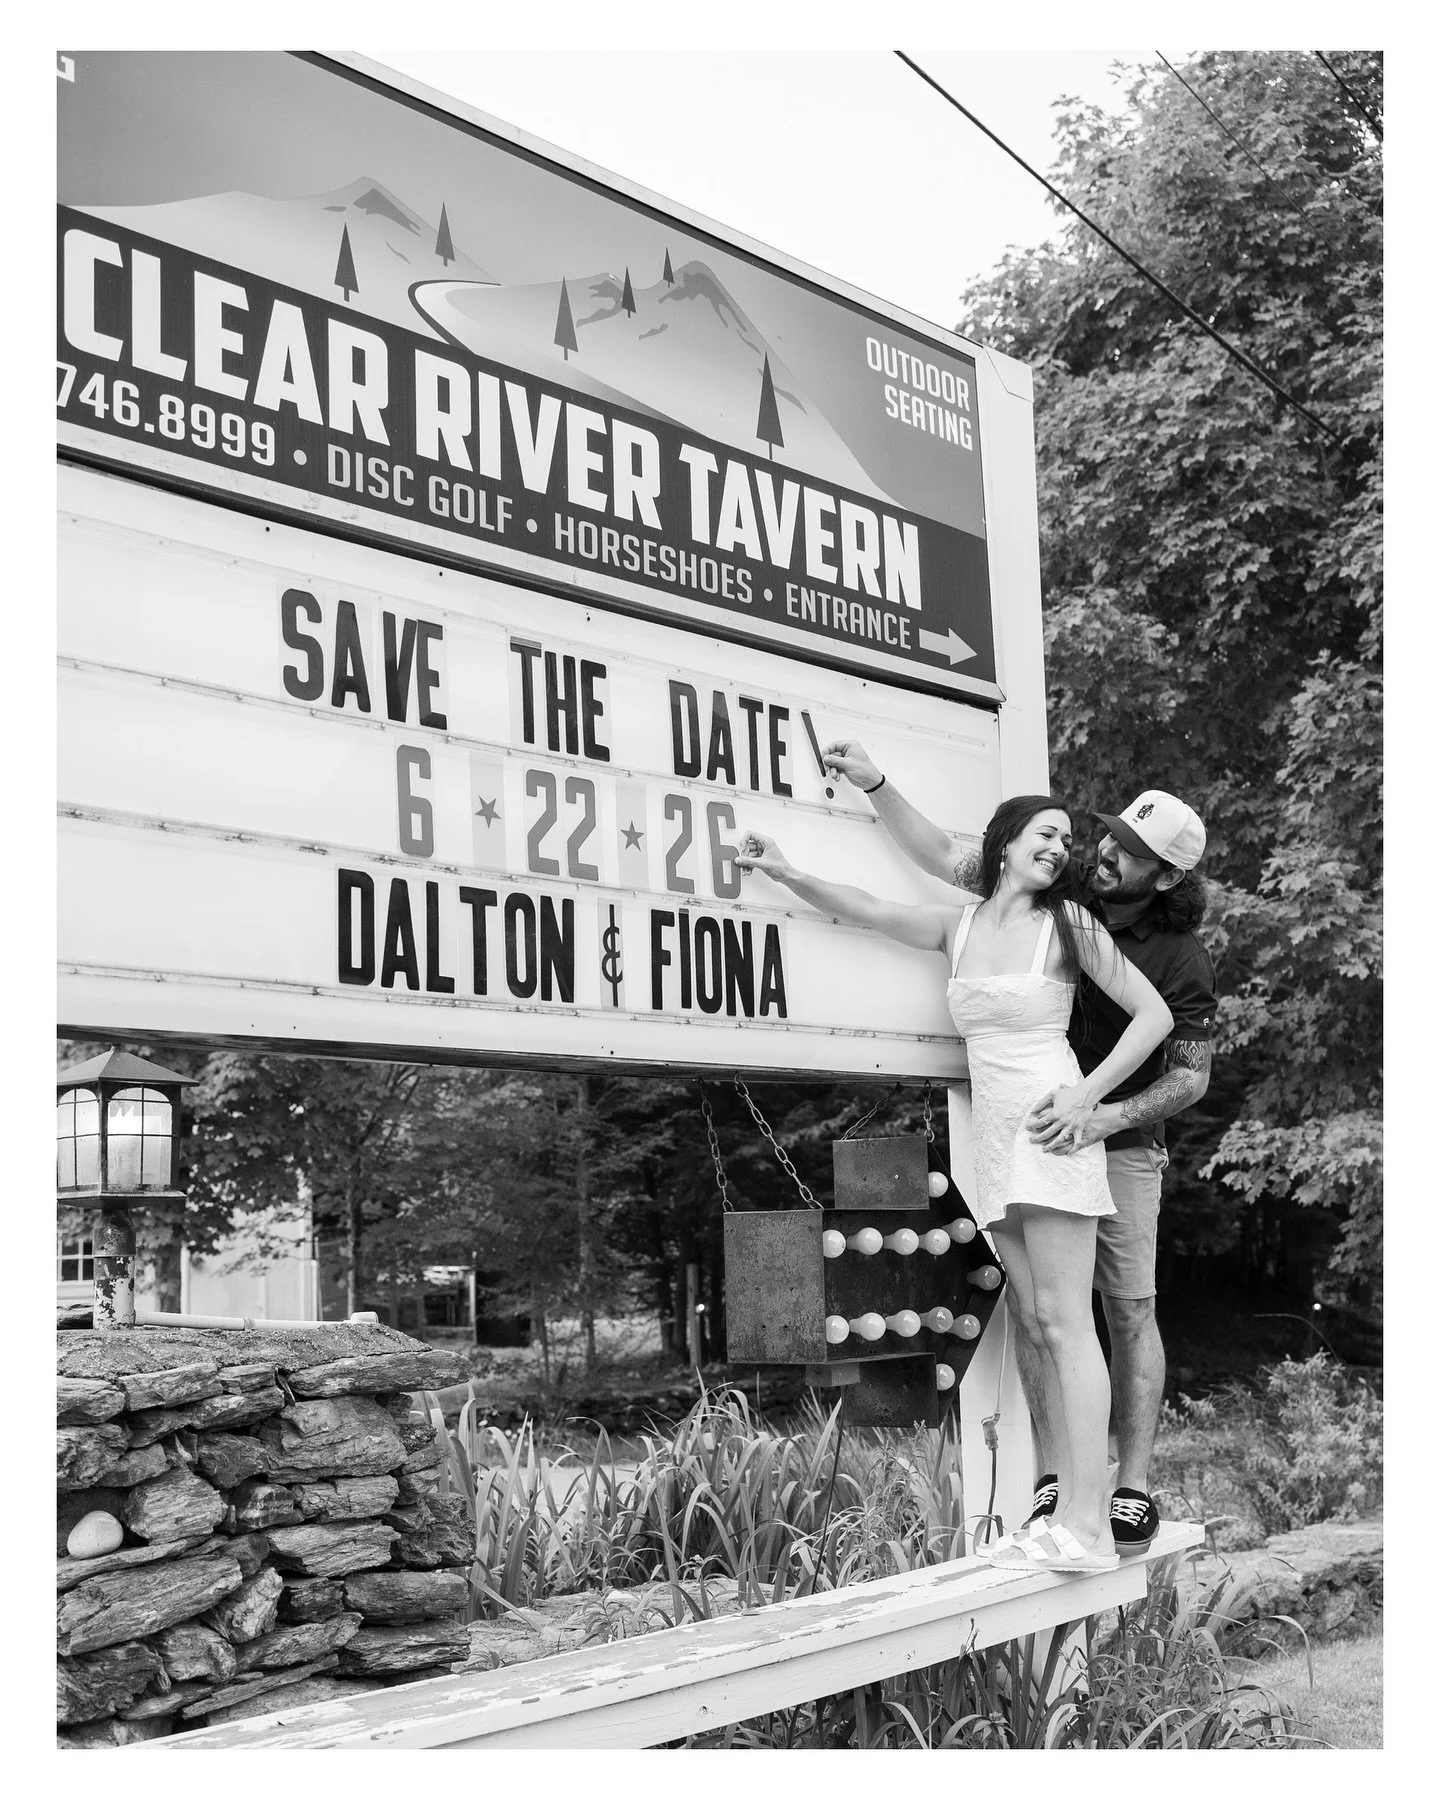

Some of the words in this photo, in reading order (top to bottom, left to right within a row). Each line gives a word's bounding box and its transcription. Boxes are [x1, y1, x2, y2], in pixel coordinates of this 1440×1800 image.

[64, 228, 390, 447] CLEAR
[415, 348, 663, 531] RIVER
[679, 443, 922, 611] TAVERN
[865, 336, 970, 412] OUTDOOR
[885, 384, 973, 451] SEATING
[327, 443, 415, 507] DISC
[428, 475, 513, 533] GOLF
[554, 512, 753, 604] HORSESHOES
[786, 583, 911, 650] ENTRANCE
[281, 588, 448, 730] SAVE
[510, 636, 611, 762] THE
[396, 744, 434, 858] 6
[525, 769, 599, 882] 22
[663, 793, 742, 899] 26
[337, 868, 575, 1004] DALTON
[601, 904, 624, 1007] &
[650, 908, 787, 1019] FIONA
